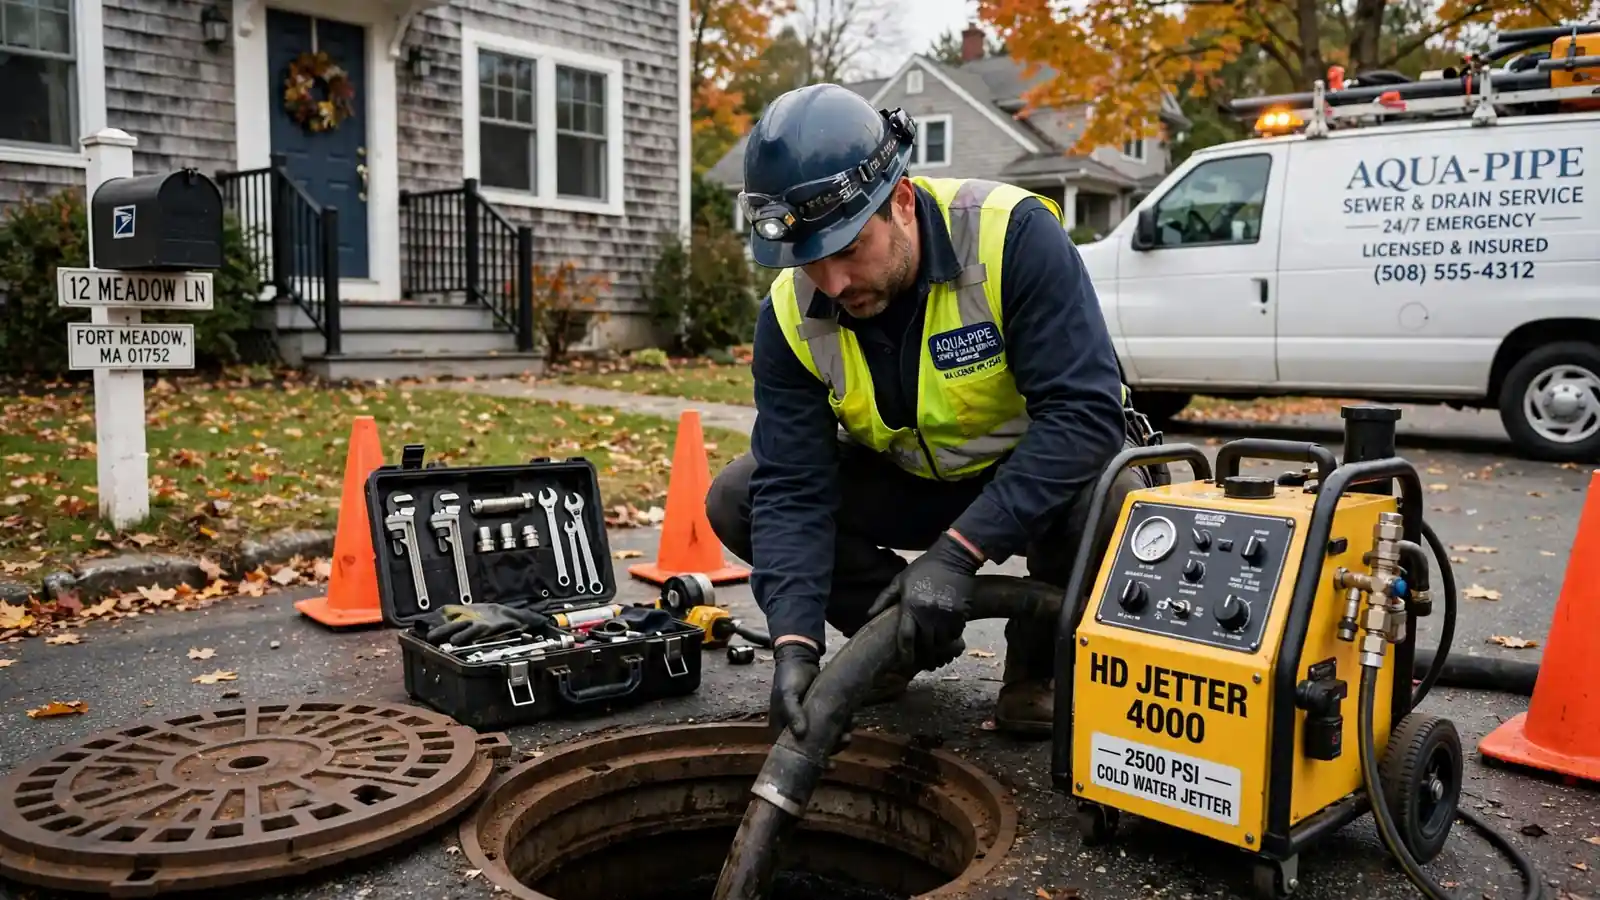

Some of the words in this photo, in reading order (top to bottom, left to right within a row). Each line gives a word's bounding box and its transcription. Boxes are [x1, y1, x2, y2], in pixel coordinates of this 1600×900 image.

[1346, 147, 1584, 191] AQUA-PIPE
[1343, 196, 1405, 214] SEWER
[1412, 195, 1425, 210] &
[1431, 191, 1491, 210] DRAIN
[1499, 186, 1584, 206] SERVICE
[1383, 217, 1420, 235] 24/7
[1426, 212, 1536, 231] EMERGENCY
[1363, 240, 1444, 258] LICENSED
[1450, 240, 1462, 255] &
[1469, 238, 1549, 254] INSURED
[1374, 263, 1427, 285] (508)
[1434, 261, 1535, 280] 555-4312
[70, 276, 91, 300] 12
[99, 277, 176, 302] MEADOW
[184, 280, 206, 302] LN
[77, 330, 114, 346] FORT
[120, 330, 187, 347] MEADOW,
[936, 327, 994, 353] AQUA-PIPE
[100, 348, 122, 363] MA
[128, 348, 170, 363] 01752
[1090, 652, 1129, 688] HD
[1136, 664, 1248, 718] JETTER
[1126, 699, 1205, 744] 4000
[1125, 748, 1166, 775] 2500
[1171, 759, 1199, 785] PSI
[1097, 763, 1129, 786] COLD
[1133, 774, 1177, 801] WATER
[1180, 788, 1232, 817] JETTER
